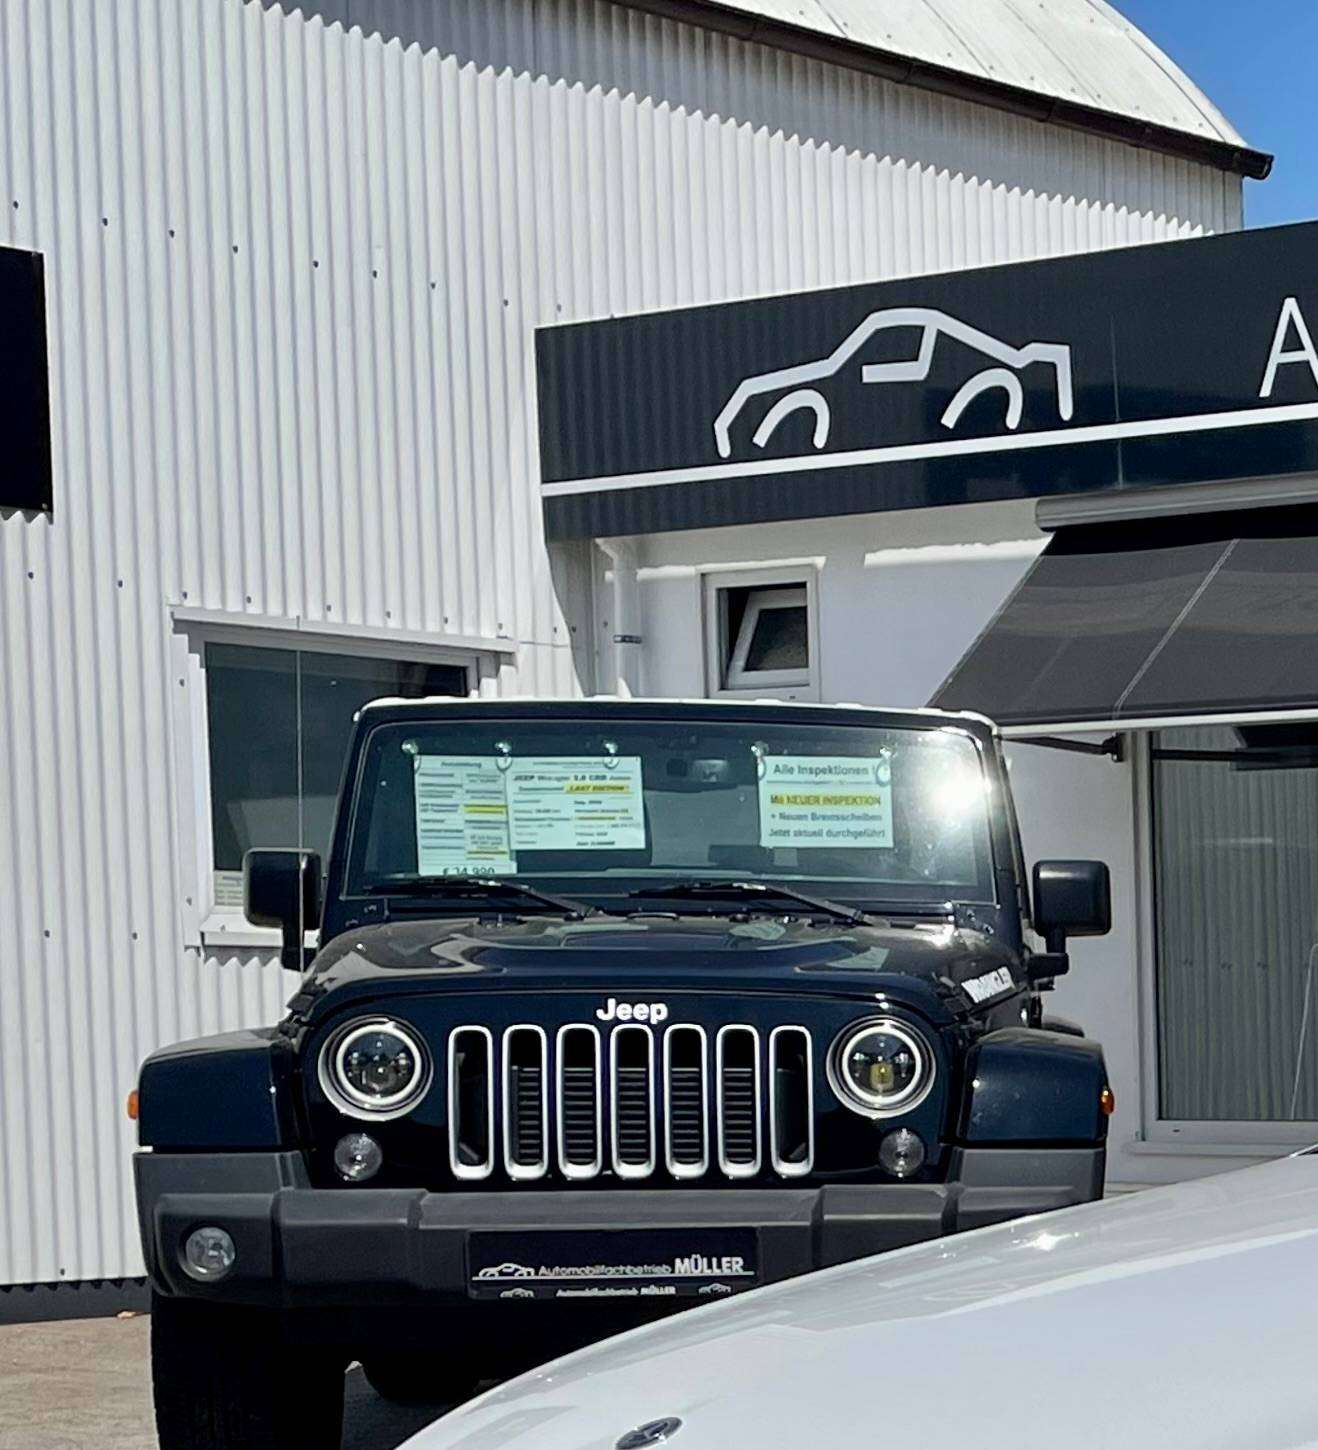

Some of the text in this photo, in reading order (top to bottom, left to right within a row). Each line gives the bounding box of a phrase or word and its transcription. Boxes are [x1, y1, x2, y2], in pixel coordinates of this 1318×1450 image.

[773, 764, 794, 776] Alle
[797, 764, 869, 778] Inspektionen
[787, 795, 820, 806] NEUER
[821, 795, 881, 806] INSPEKTION
[825, 828, 885, 840] durchgeführt
[595, 997, 668, 1025] Jeep
[538, 1253, 744, 1277] Automobilfachbetrieb MÜLLER
[640, 1284, 676, 1296] MÜLLER
